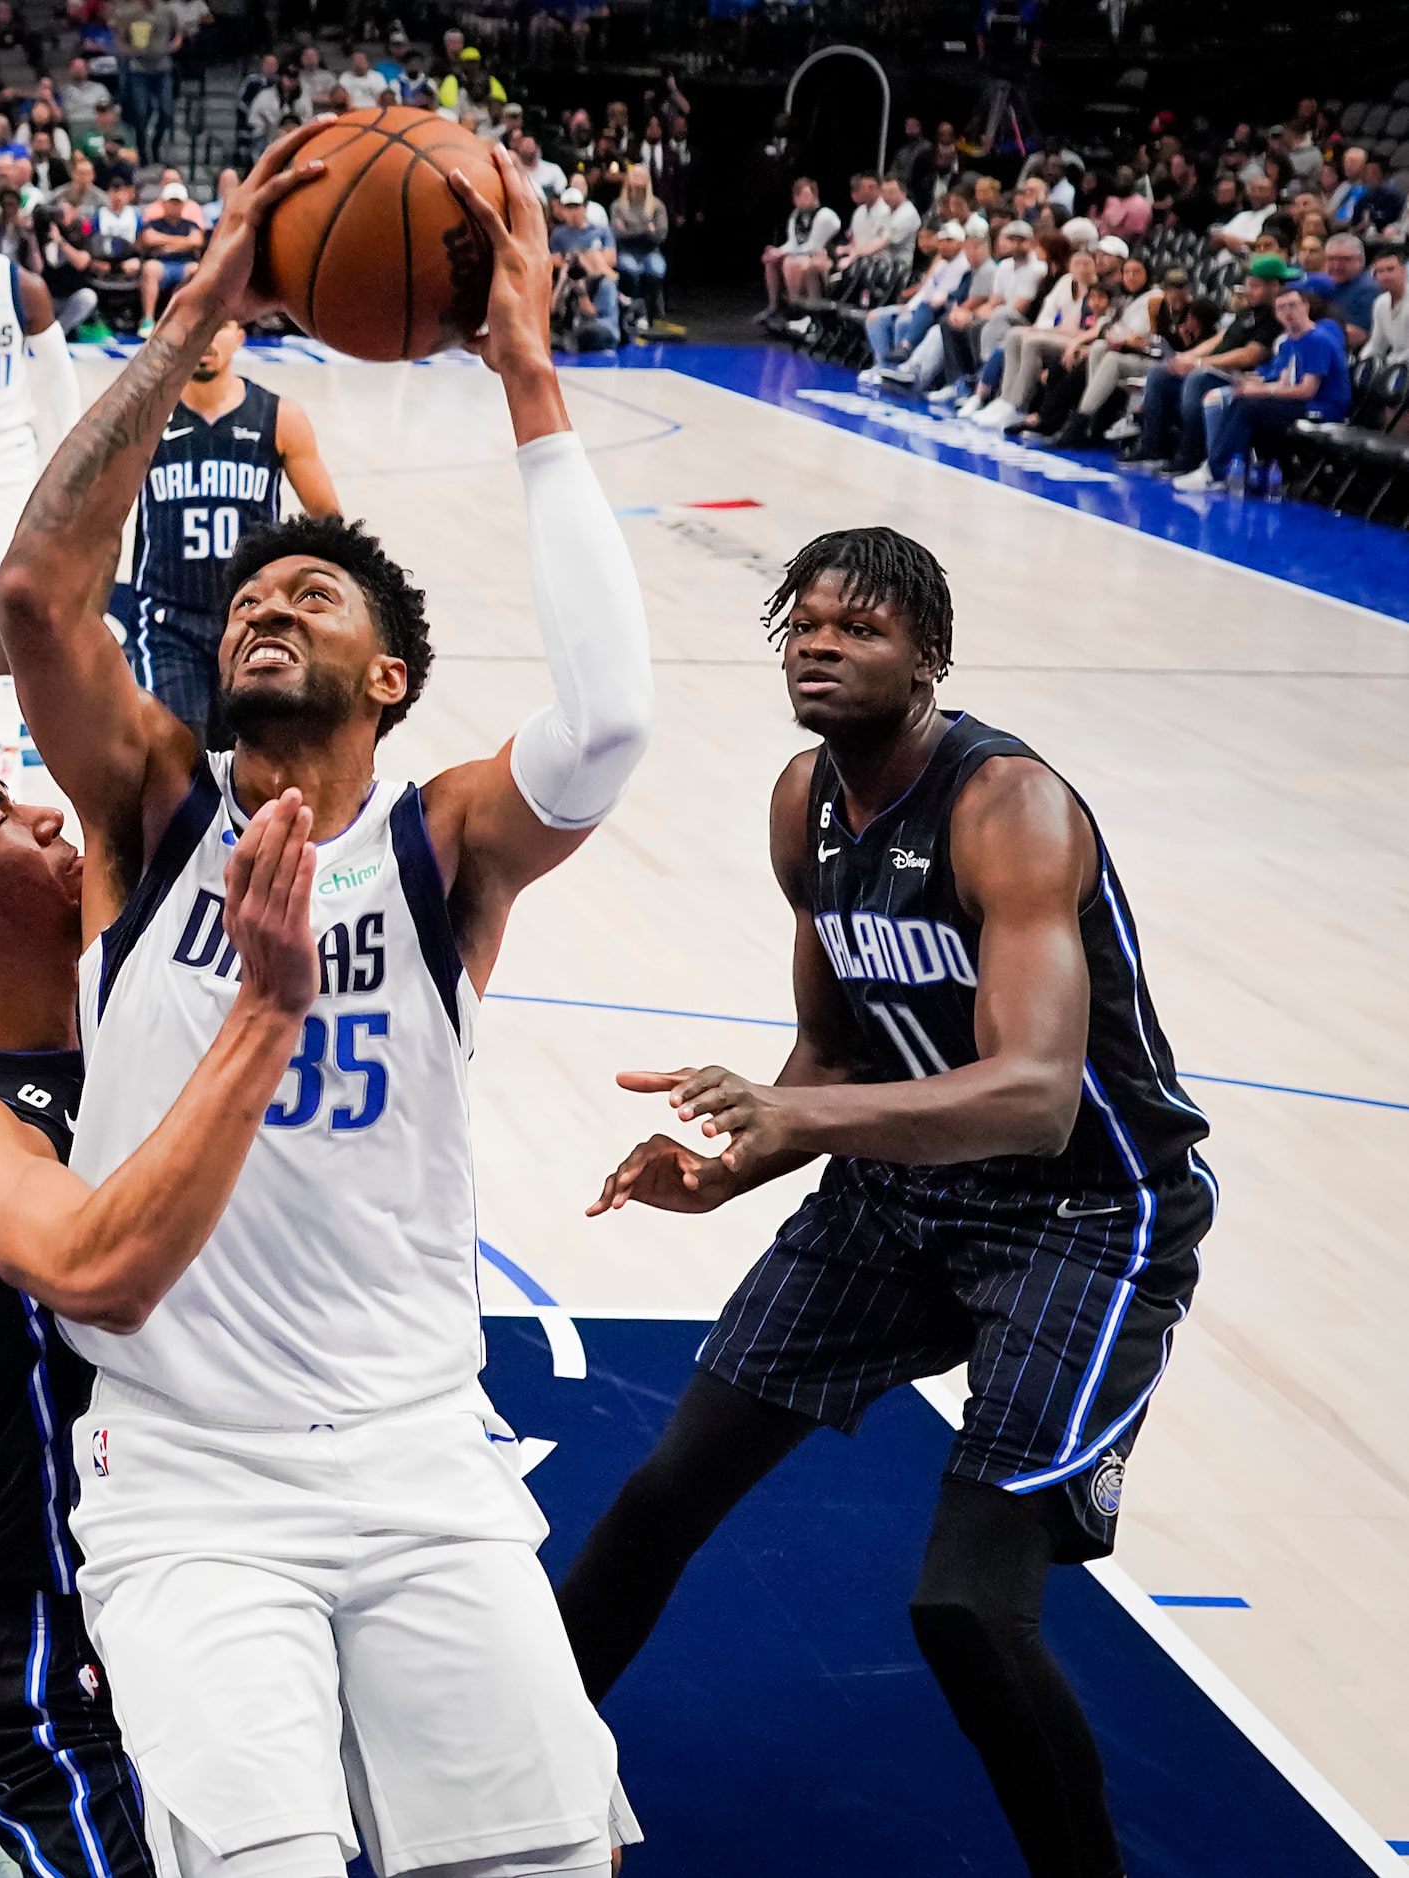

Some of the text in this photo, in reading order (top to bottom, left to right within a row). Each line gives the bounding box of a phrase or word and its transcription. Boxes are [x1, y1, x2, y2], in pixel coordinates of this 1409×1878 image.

[150, 460, 269, 502] ORLANDO
[183, 506, 239, 559] 50
[819, 802, 832, 828] 6
[318, 860, 383, 895] chim
[890, 848, 930, 875] Disney
[169, 887, 386, 998] DAS
[867, 1001, 951, 1080] 11
[259, 1012, 389, 1132] 35
[17, 1084, 52, 1109] 6
